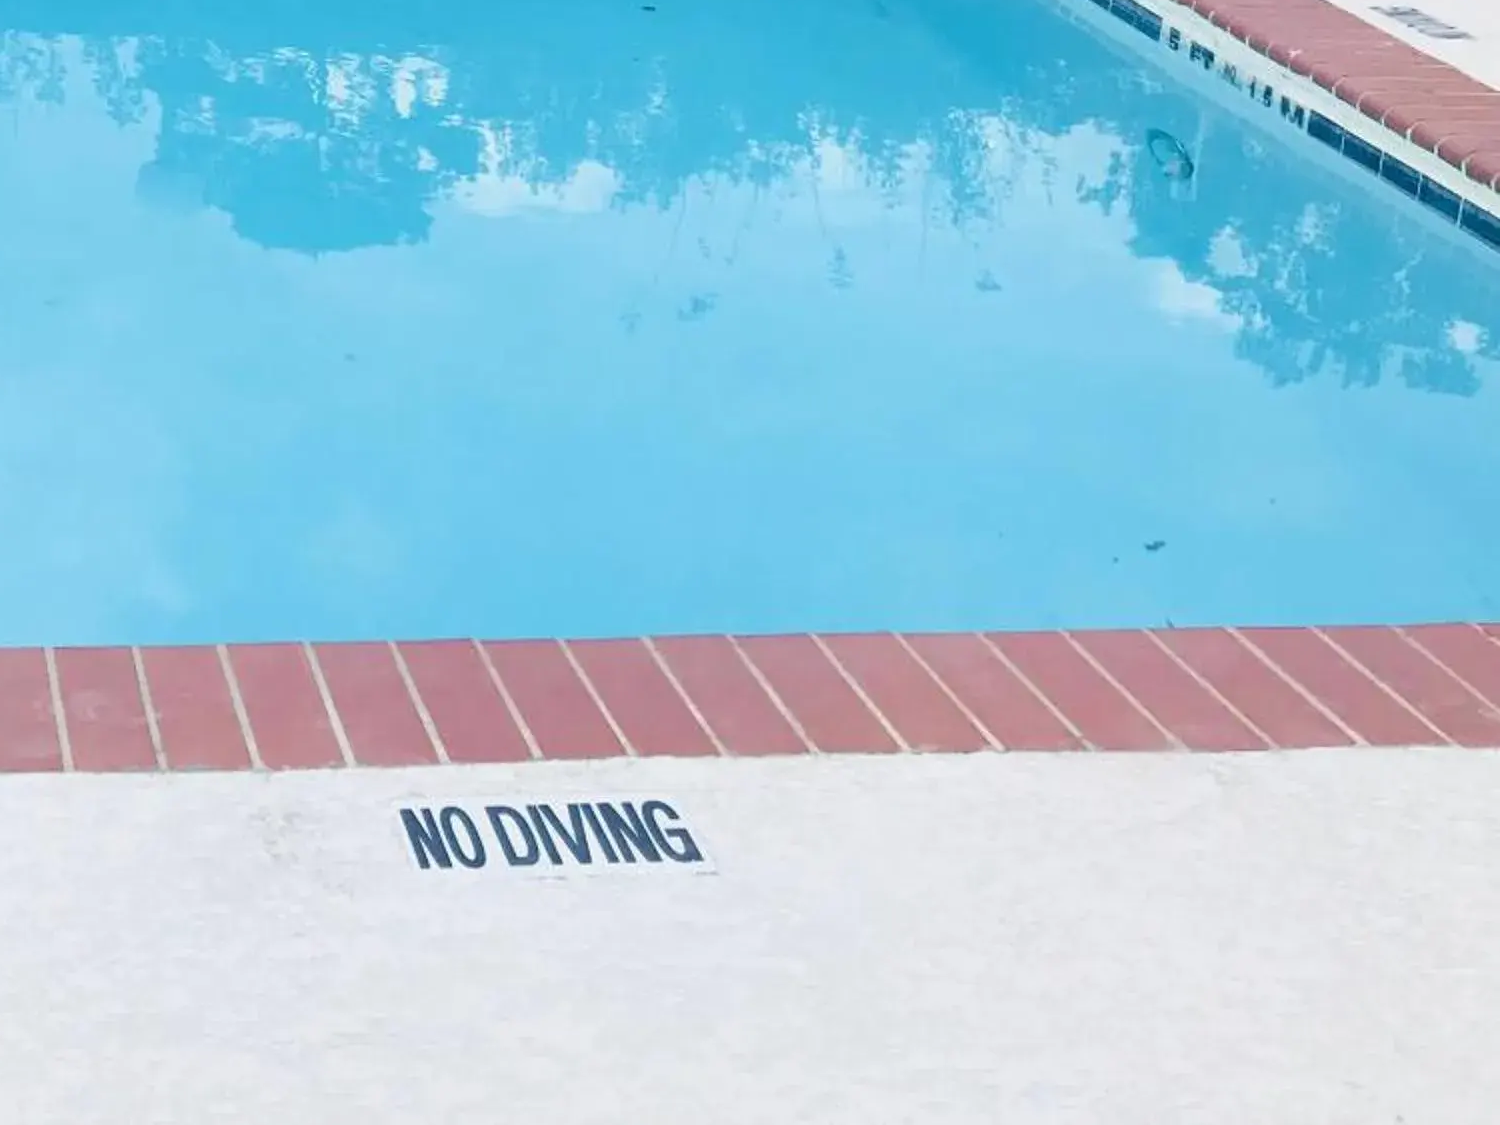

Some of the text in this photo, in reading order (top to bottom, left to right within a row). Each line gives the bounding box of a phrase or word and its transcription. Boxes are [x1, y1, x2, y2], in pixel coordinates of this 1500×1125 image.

[1168, 27, 1215, 70] 5 FT
[400, 800, 705, 869] NO DIVING
